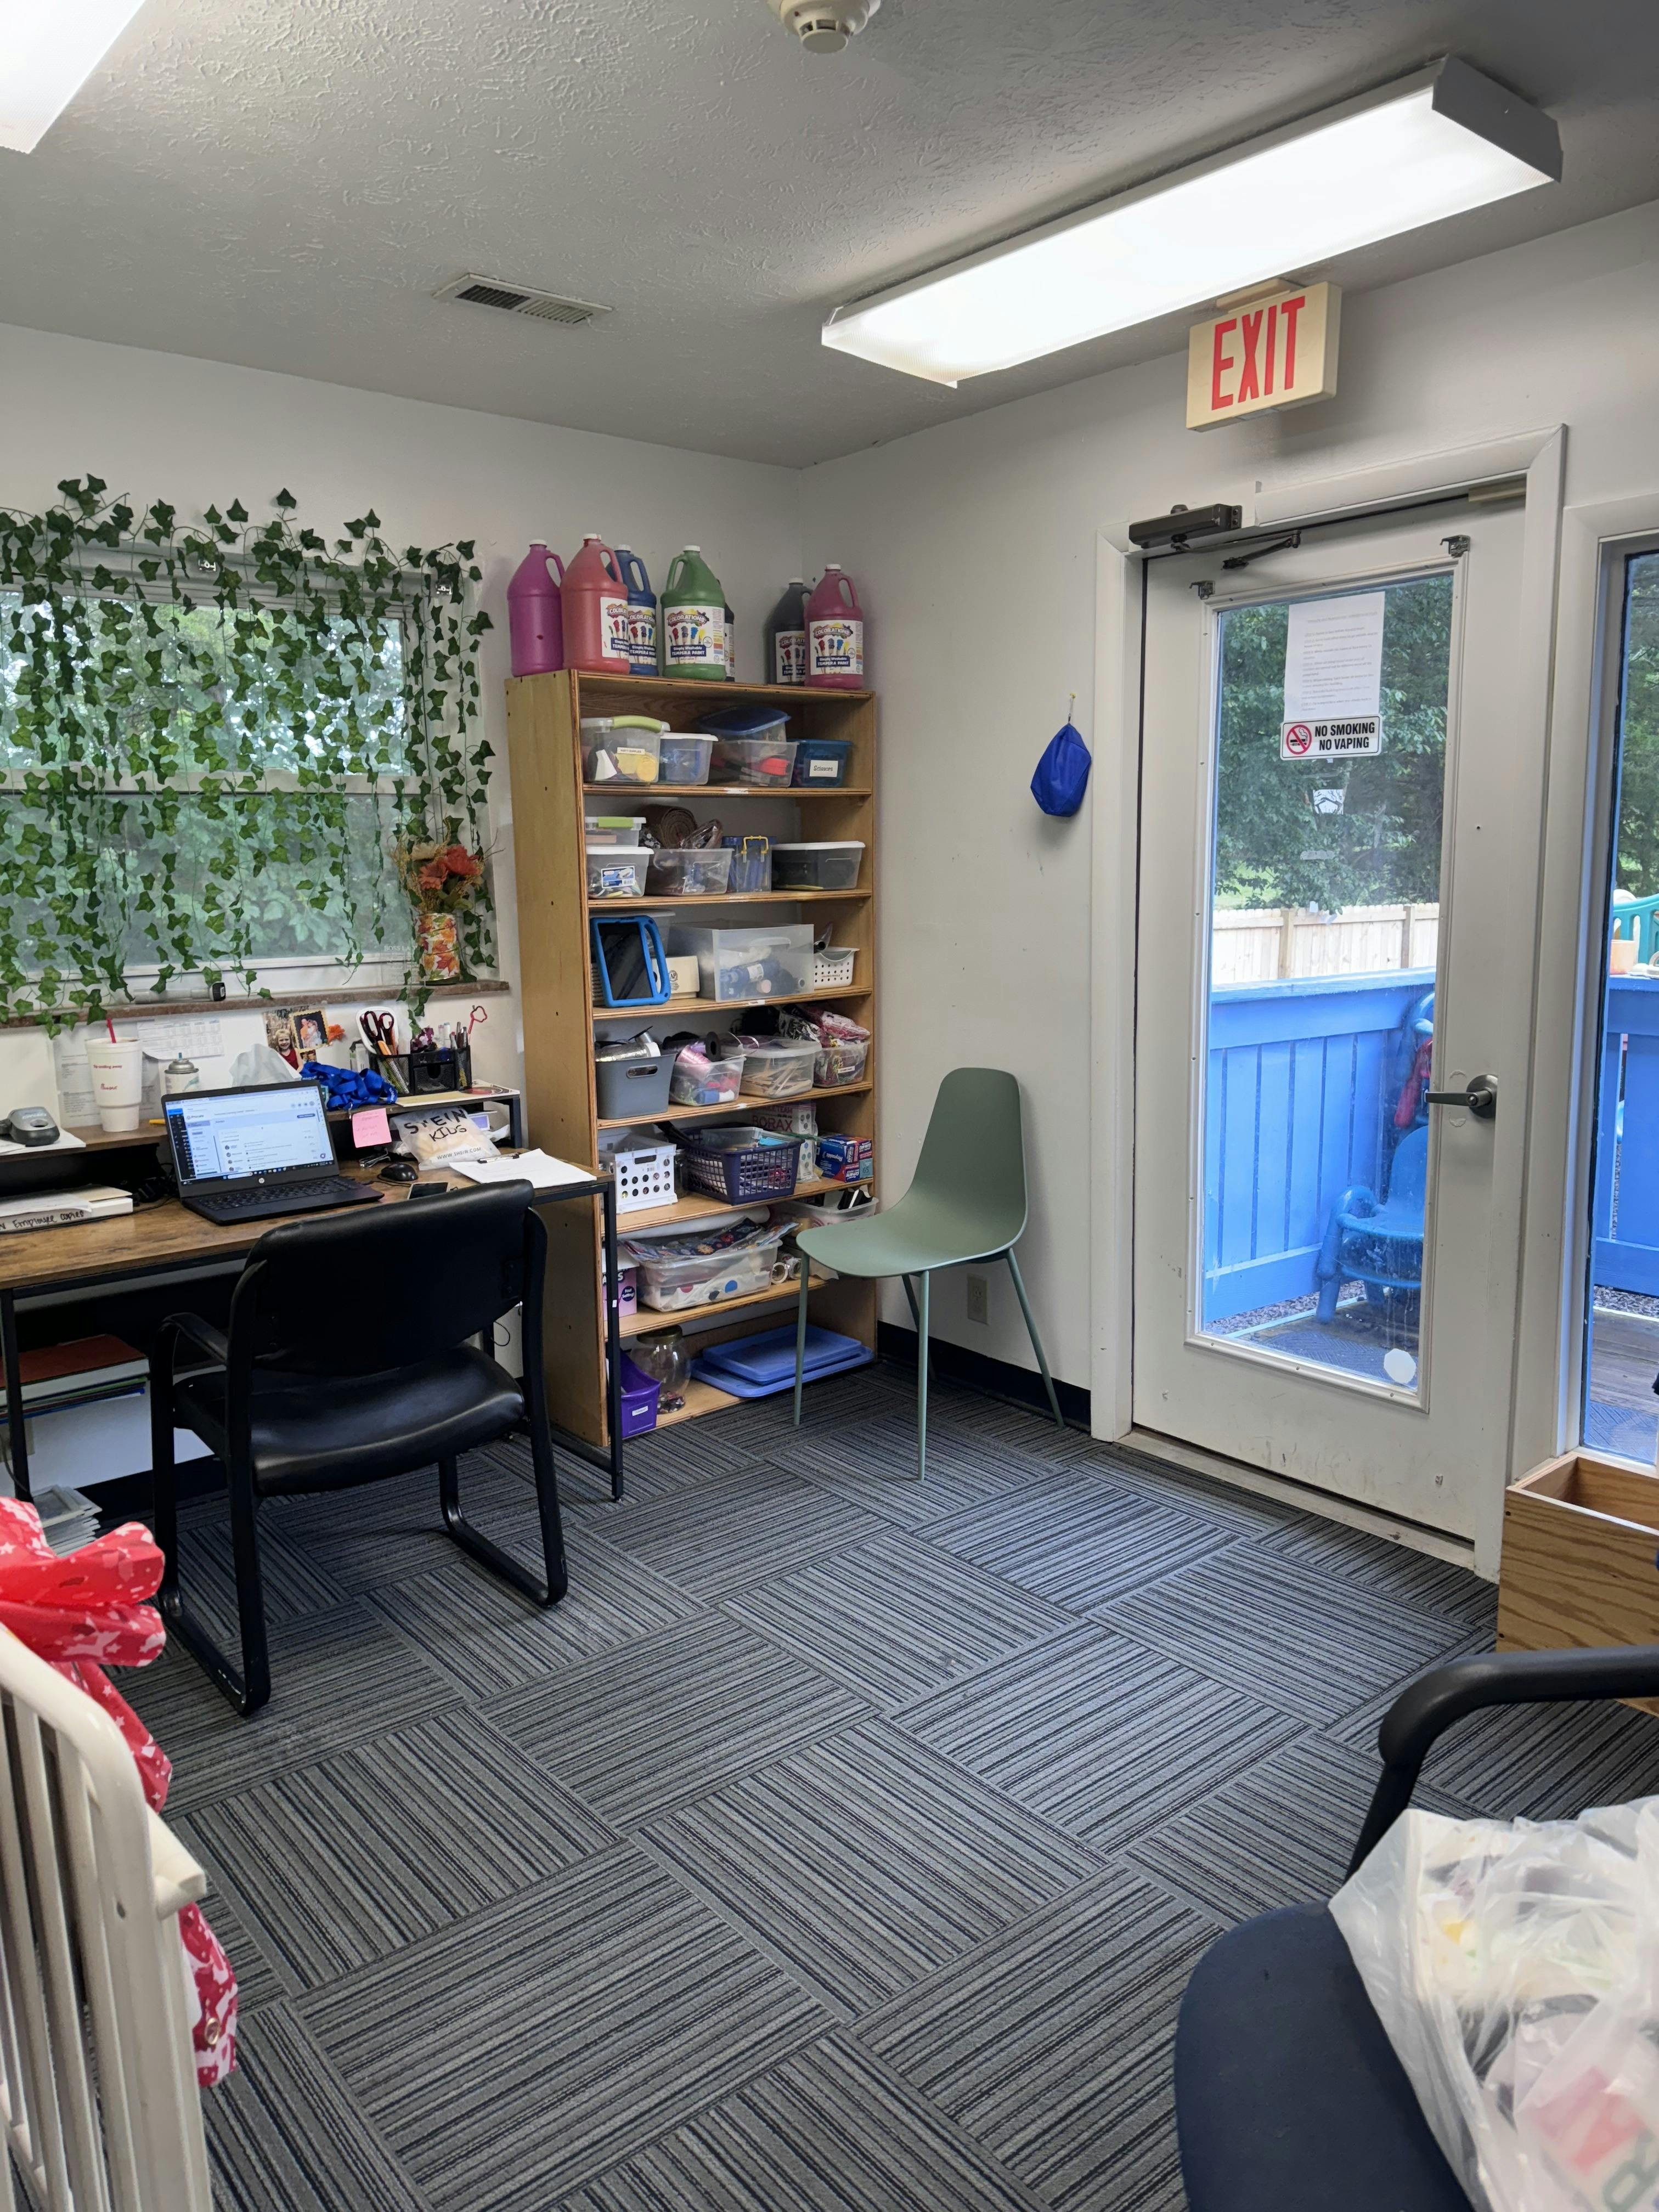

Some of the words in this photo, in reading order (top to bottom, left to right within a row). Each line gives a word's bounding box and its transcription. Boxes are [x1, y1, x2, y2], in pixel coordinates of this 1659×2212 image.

[1211, 296, 1305, 410] EXIT
[1314, 725, 1328, 737] NO
[1330, 722, 1375, 736] SMOKING
[1319, 739, 1332, 751] NO
[1334, 737, 1369, 750] VAPING
[752, 1115, 793, 1132] BORAX
